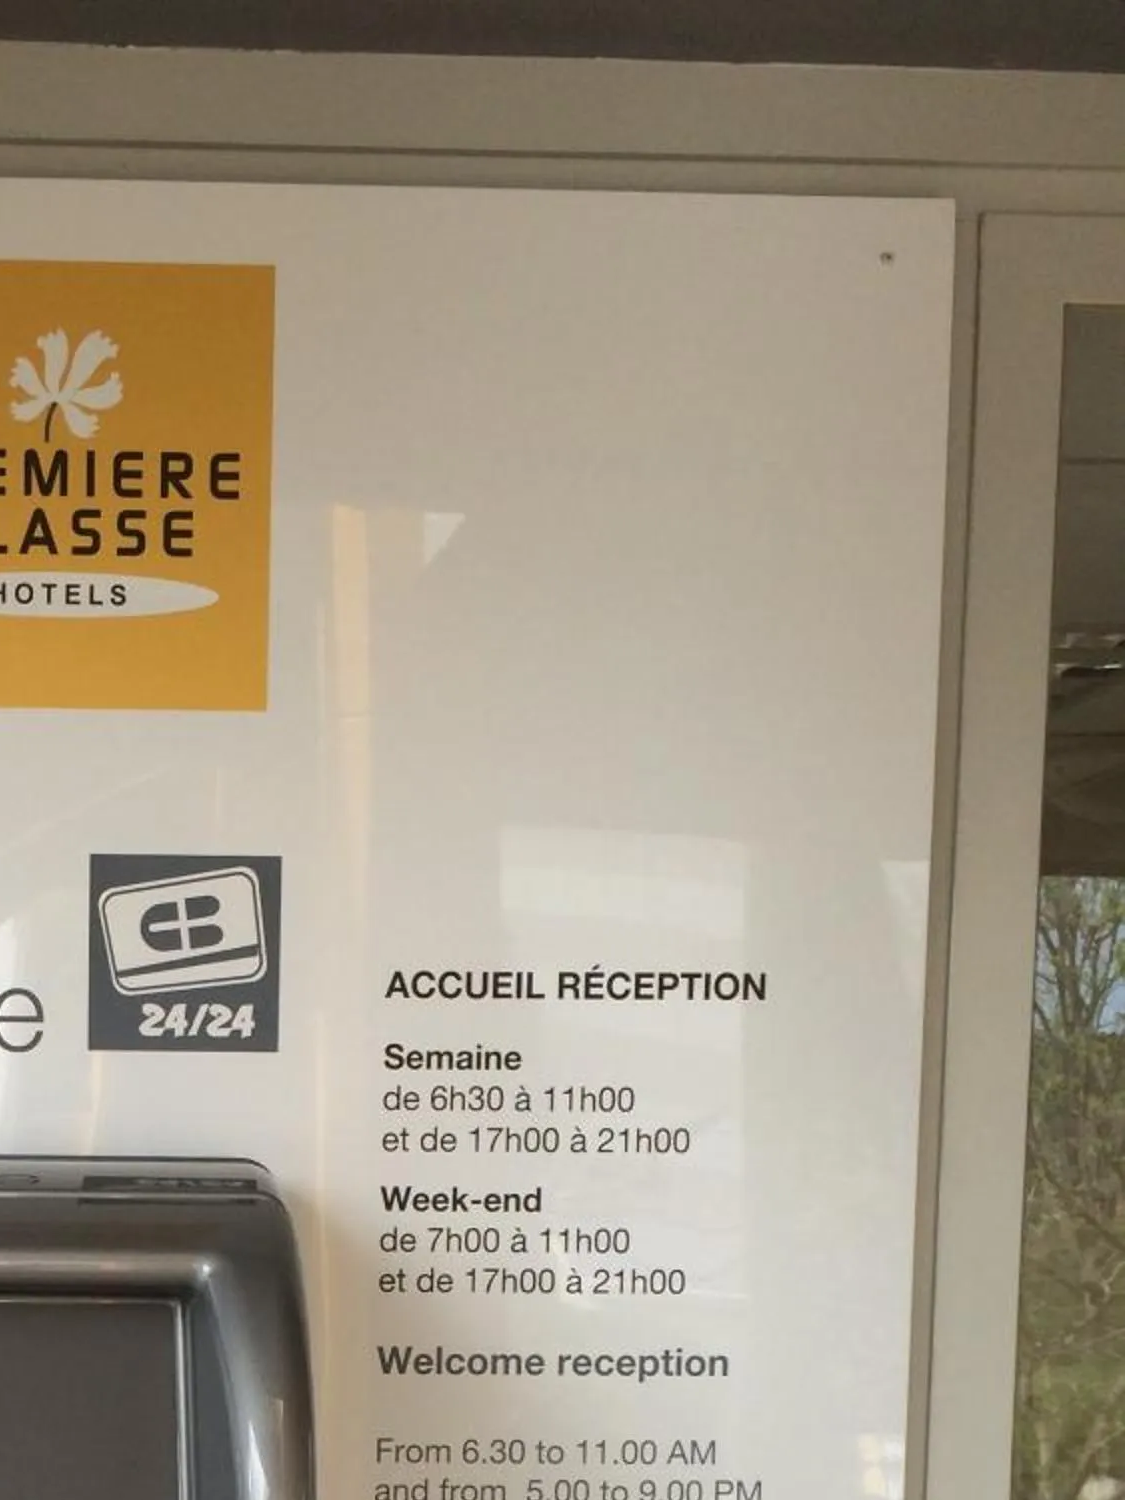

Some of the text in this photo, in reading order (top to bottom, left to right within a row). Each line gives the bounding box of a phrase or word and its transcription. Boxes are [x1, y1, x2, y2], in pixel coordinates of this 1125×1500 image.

[384, 963, 767, 1002] ACCUEIL RÉCEPTION
[139, 1003, 255, 1039] 24/24
[383, 1042, 524, 1072] Semaine
[381, 1083, 636, 1114] de 6h30 à 11h00
[381, 1125, 691, 1155] et de 17h00 à 21h00
[379, 1184, 543, 1214] Week-end
[378, 1225, 631, 1255] de 7h00 à 11h00
[378, 1266, 686, 1296] et de 17h00 à 21h00
[376, 1344, 730, 1385] Welcome reception
[375, 1437, 717, 1467] From 6.30 to 11.00 AM
